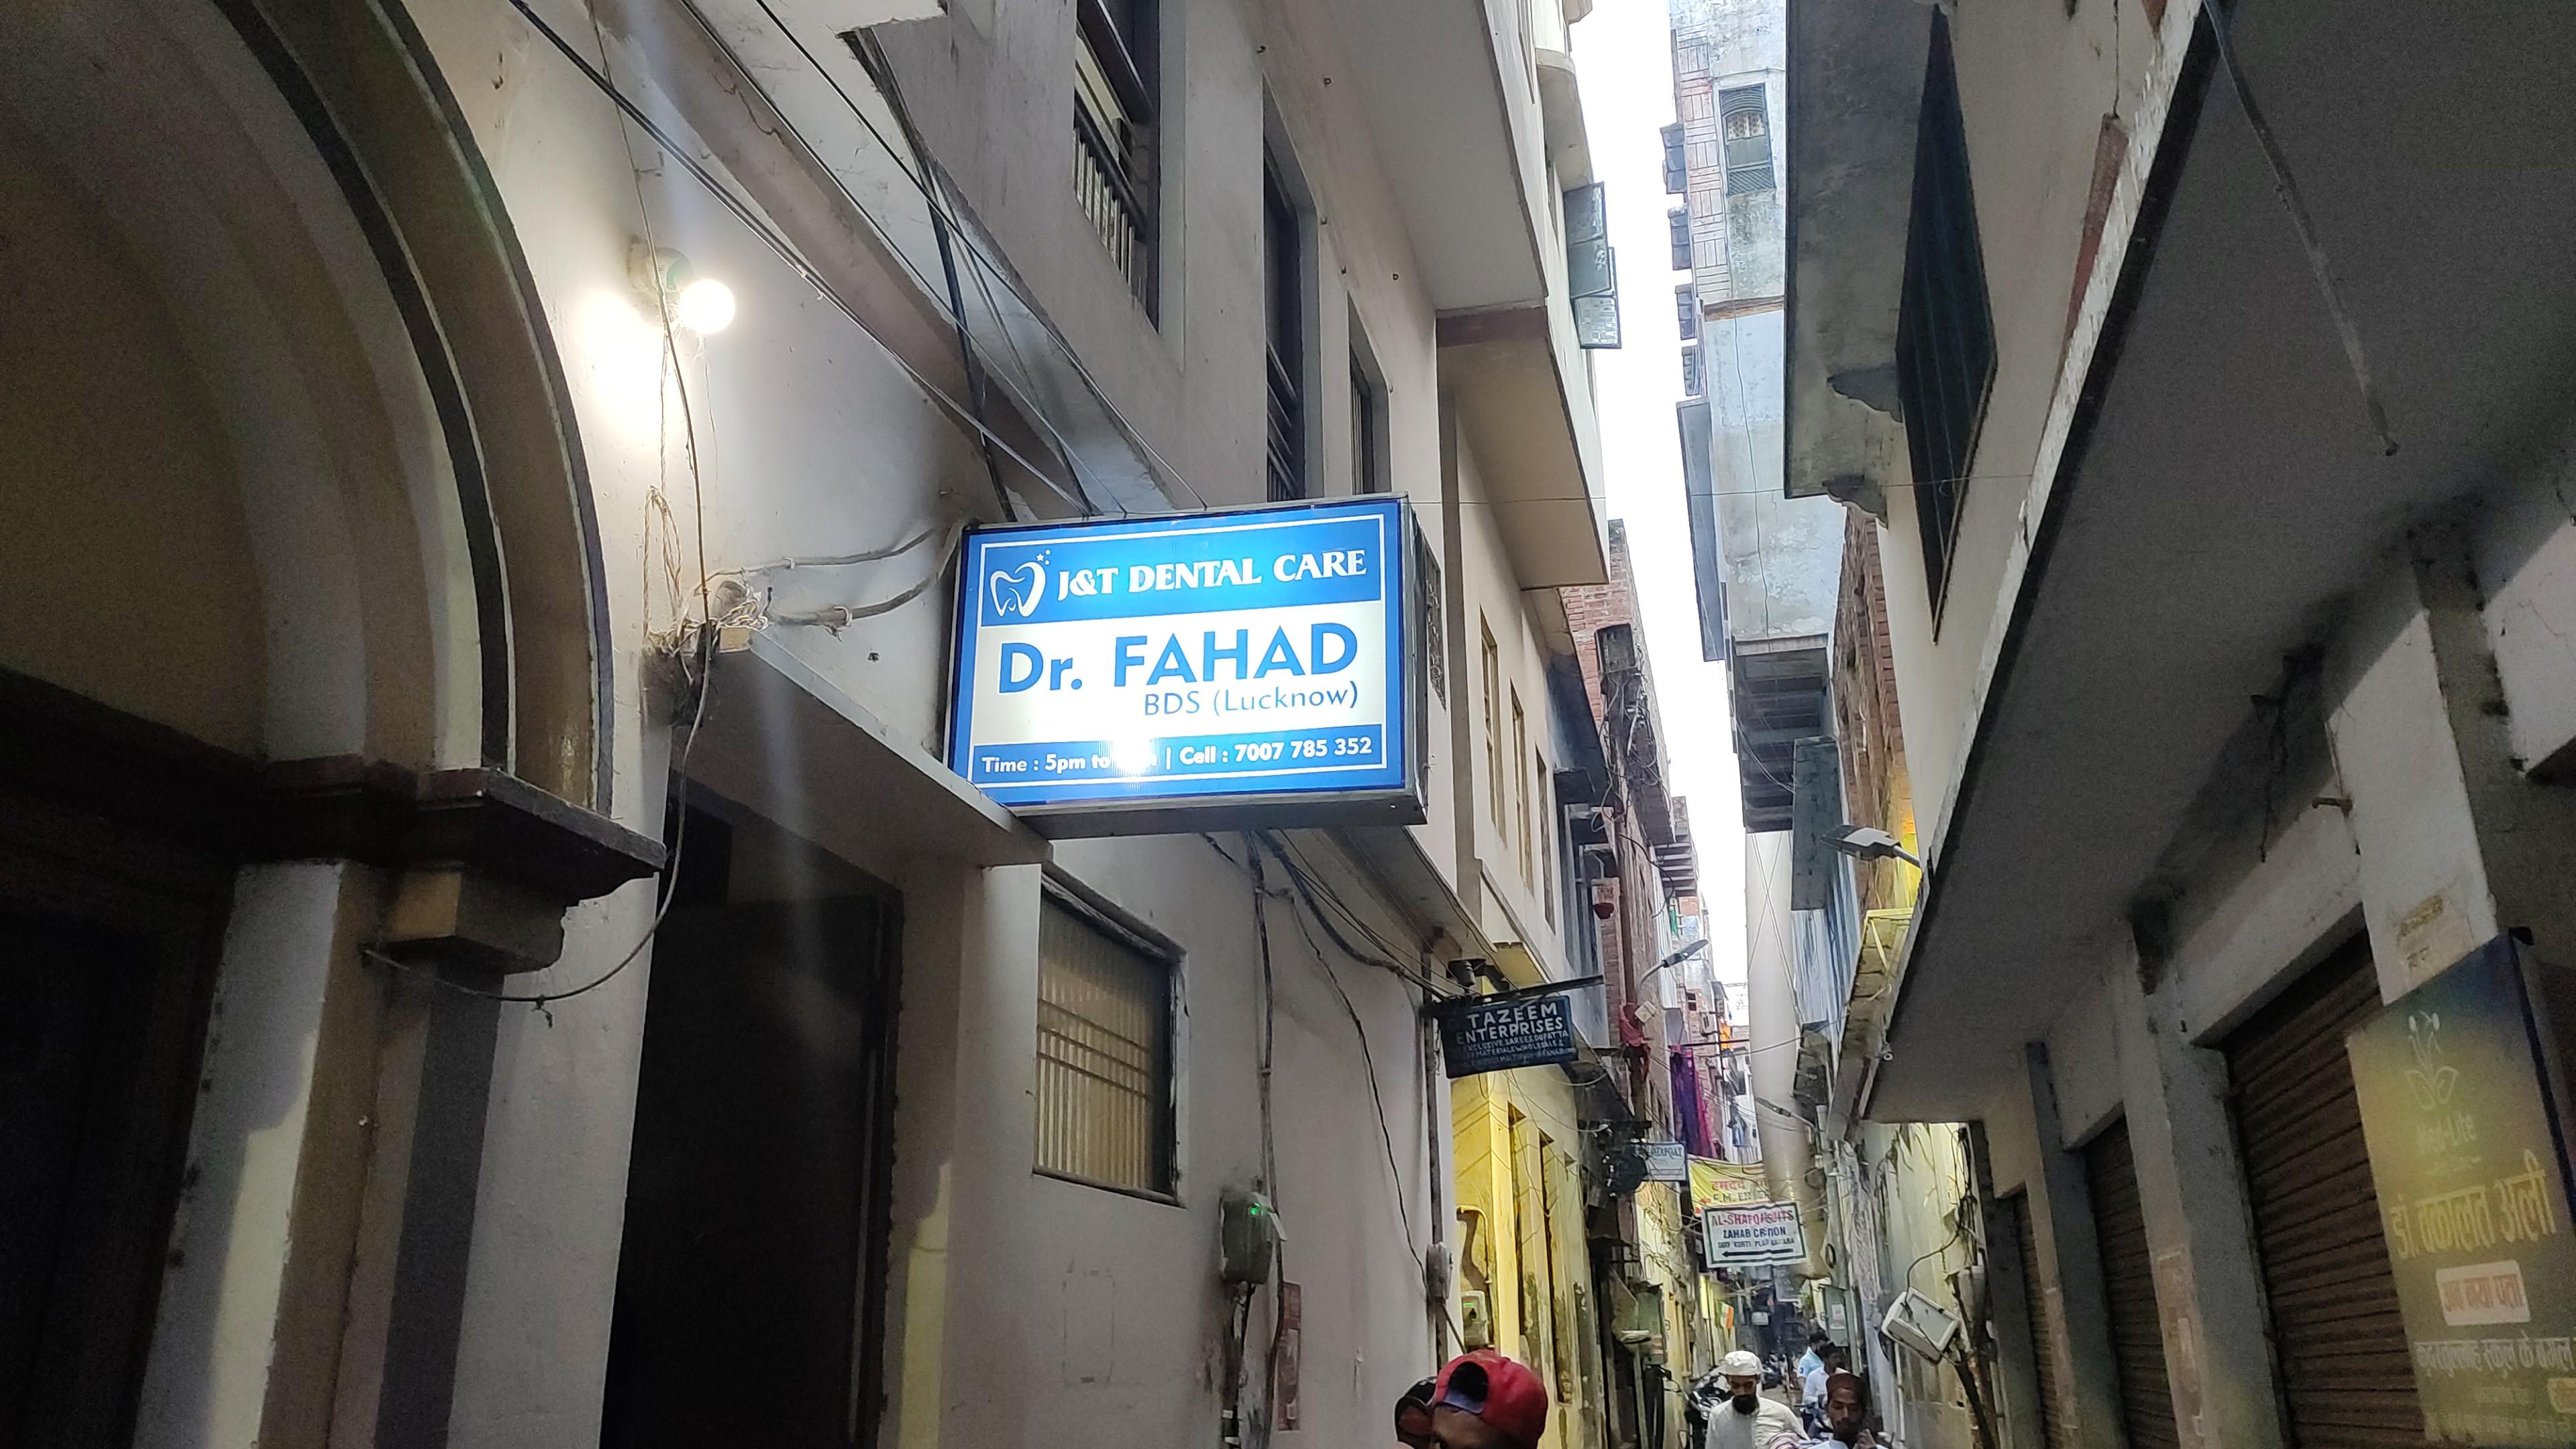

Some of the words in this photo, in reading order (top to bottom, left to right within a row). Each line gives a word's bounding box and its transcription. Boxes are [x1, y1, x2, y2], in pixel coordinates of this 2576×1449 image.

[1057, 568, 1119, 601] J&T
[1128, 557, 1263, 594] DENTAL
[1273, 549, 1368, 582] CARE
[1000, 642, 1083, 694] Dr.
[1114, 622, 1358, 688] FAHAD
[1144, 690, 1201, 716] BDS
[1213, 680, 1358, 717] (Lucknow)
[981, 756, 1028, 773] Time
[1044, 753, 1086, 775] 5pm
[1091, 753, 1111, 769] to
[1179, 745, 1216, 765] Cell
[1234, 741, 1285, 762] 7007
[1289, 739, 1328, 759] 785
[1333, 737, 1373, 756] 352
[1456, 1016, 1564, 1045] ENTERPRISES
[1467, 1002, 1558, 1028] TAZEEM
[2493, 1148, 2557, 1243] अली
[1723, 1228, 1752, 1239] ZAHAB
